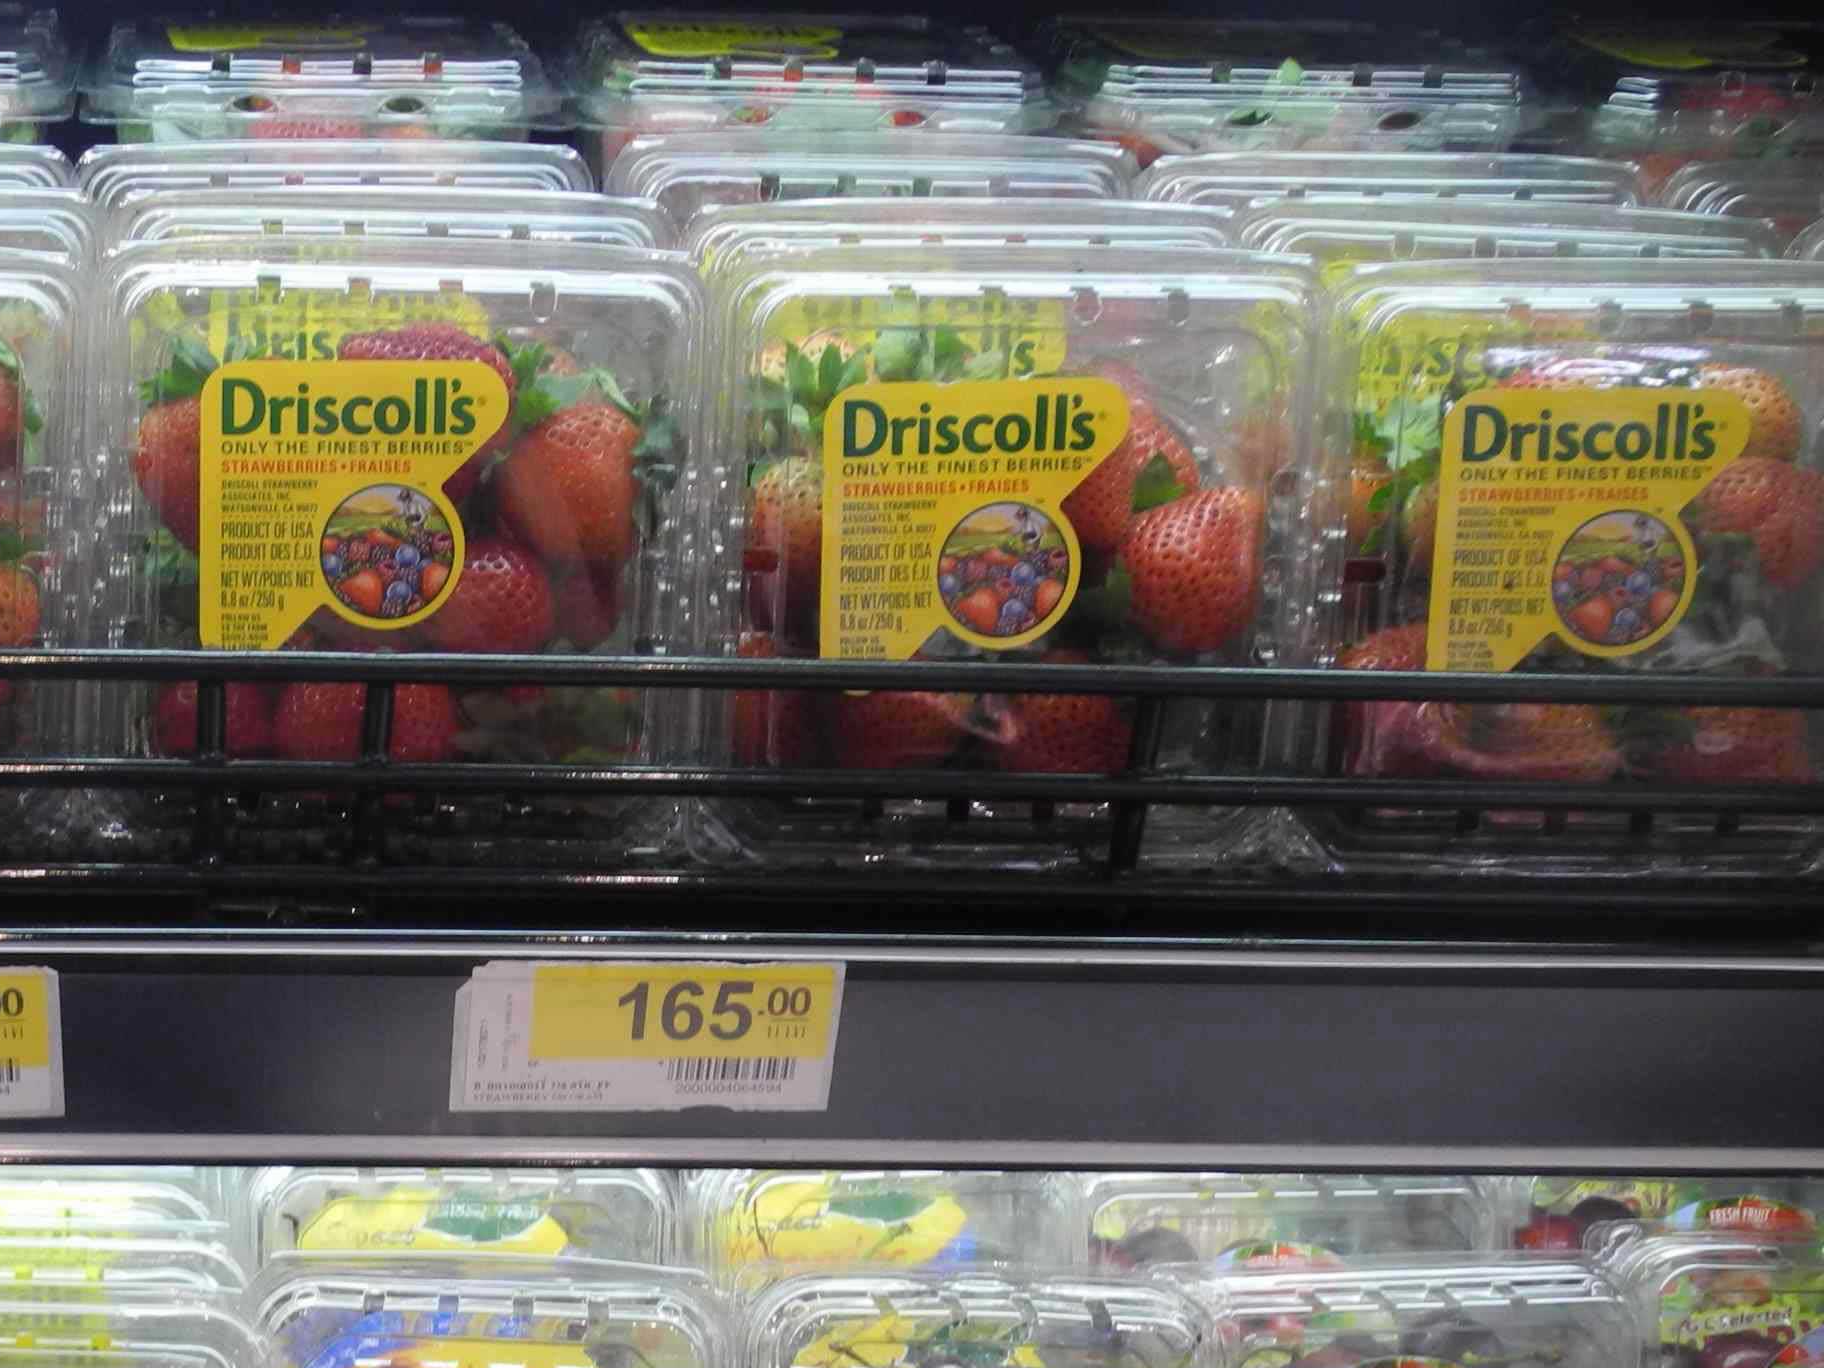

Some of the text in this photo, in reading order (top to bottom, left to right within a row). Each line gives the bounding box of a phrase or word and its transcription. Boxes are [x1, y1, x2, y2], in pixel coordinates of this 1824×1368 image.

[221, 378, 476, 435] Driscoll's
[842, 394, 1095, 457] Driscoll's
[1462, 403, 1715, 463] Driscoll's
[221, 440, 464, 455] ONLY THE FINEST BERRIES
[221, 460, 411, 474] STRAWBERRIES FRAISES
[842, 457, 1082, 477] ONLY THE FINEST BERRIES
[1460, 466, 1701, 482] ONLY THE FINEST BERRIES
[843, 479, 1029, 497] STRAWBERRIES FRAISES
[221, 521, 314, 539] PRODUCT OF USA
[221, 543, 266, 561] PRODUIT
[270, 543, 290, 560] DES
[1710, 1206, 1770, 1223] FRESH FRUIT
